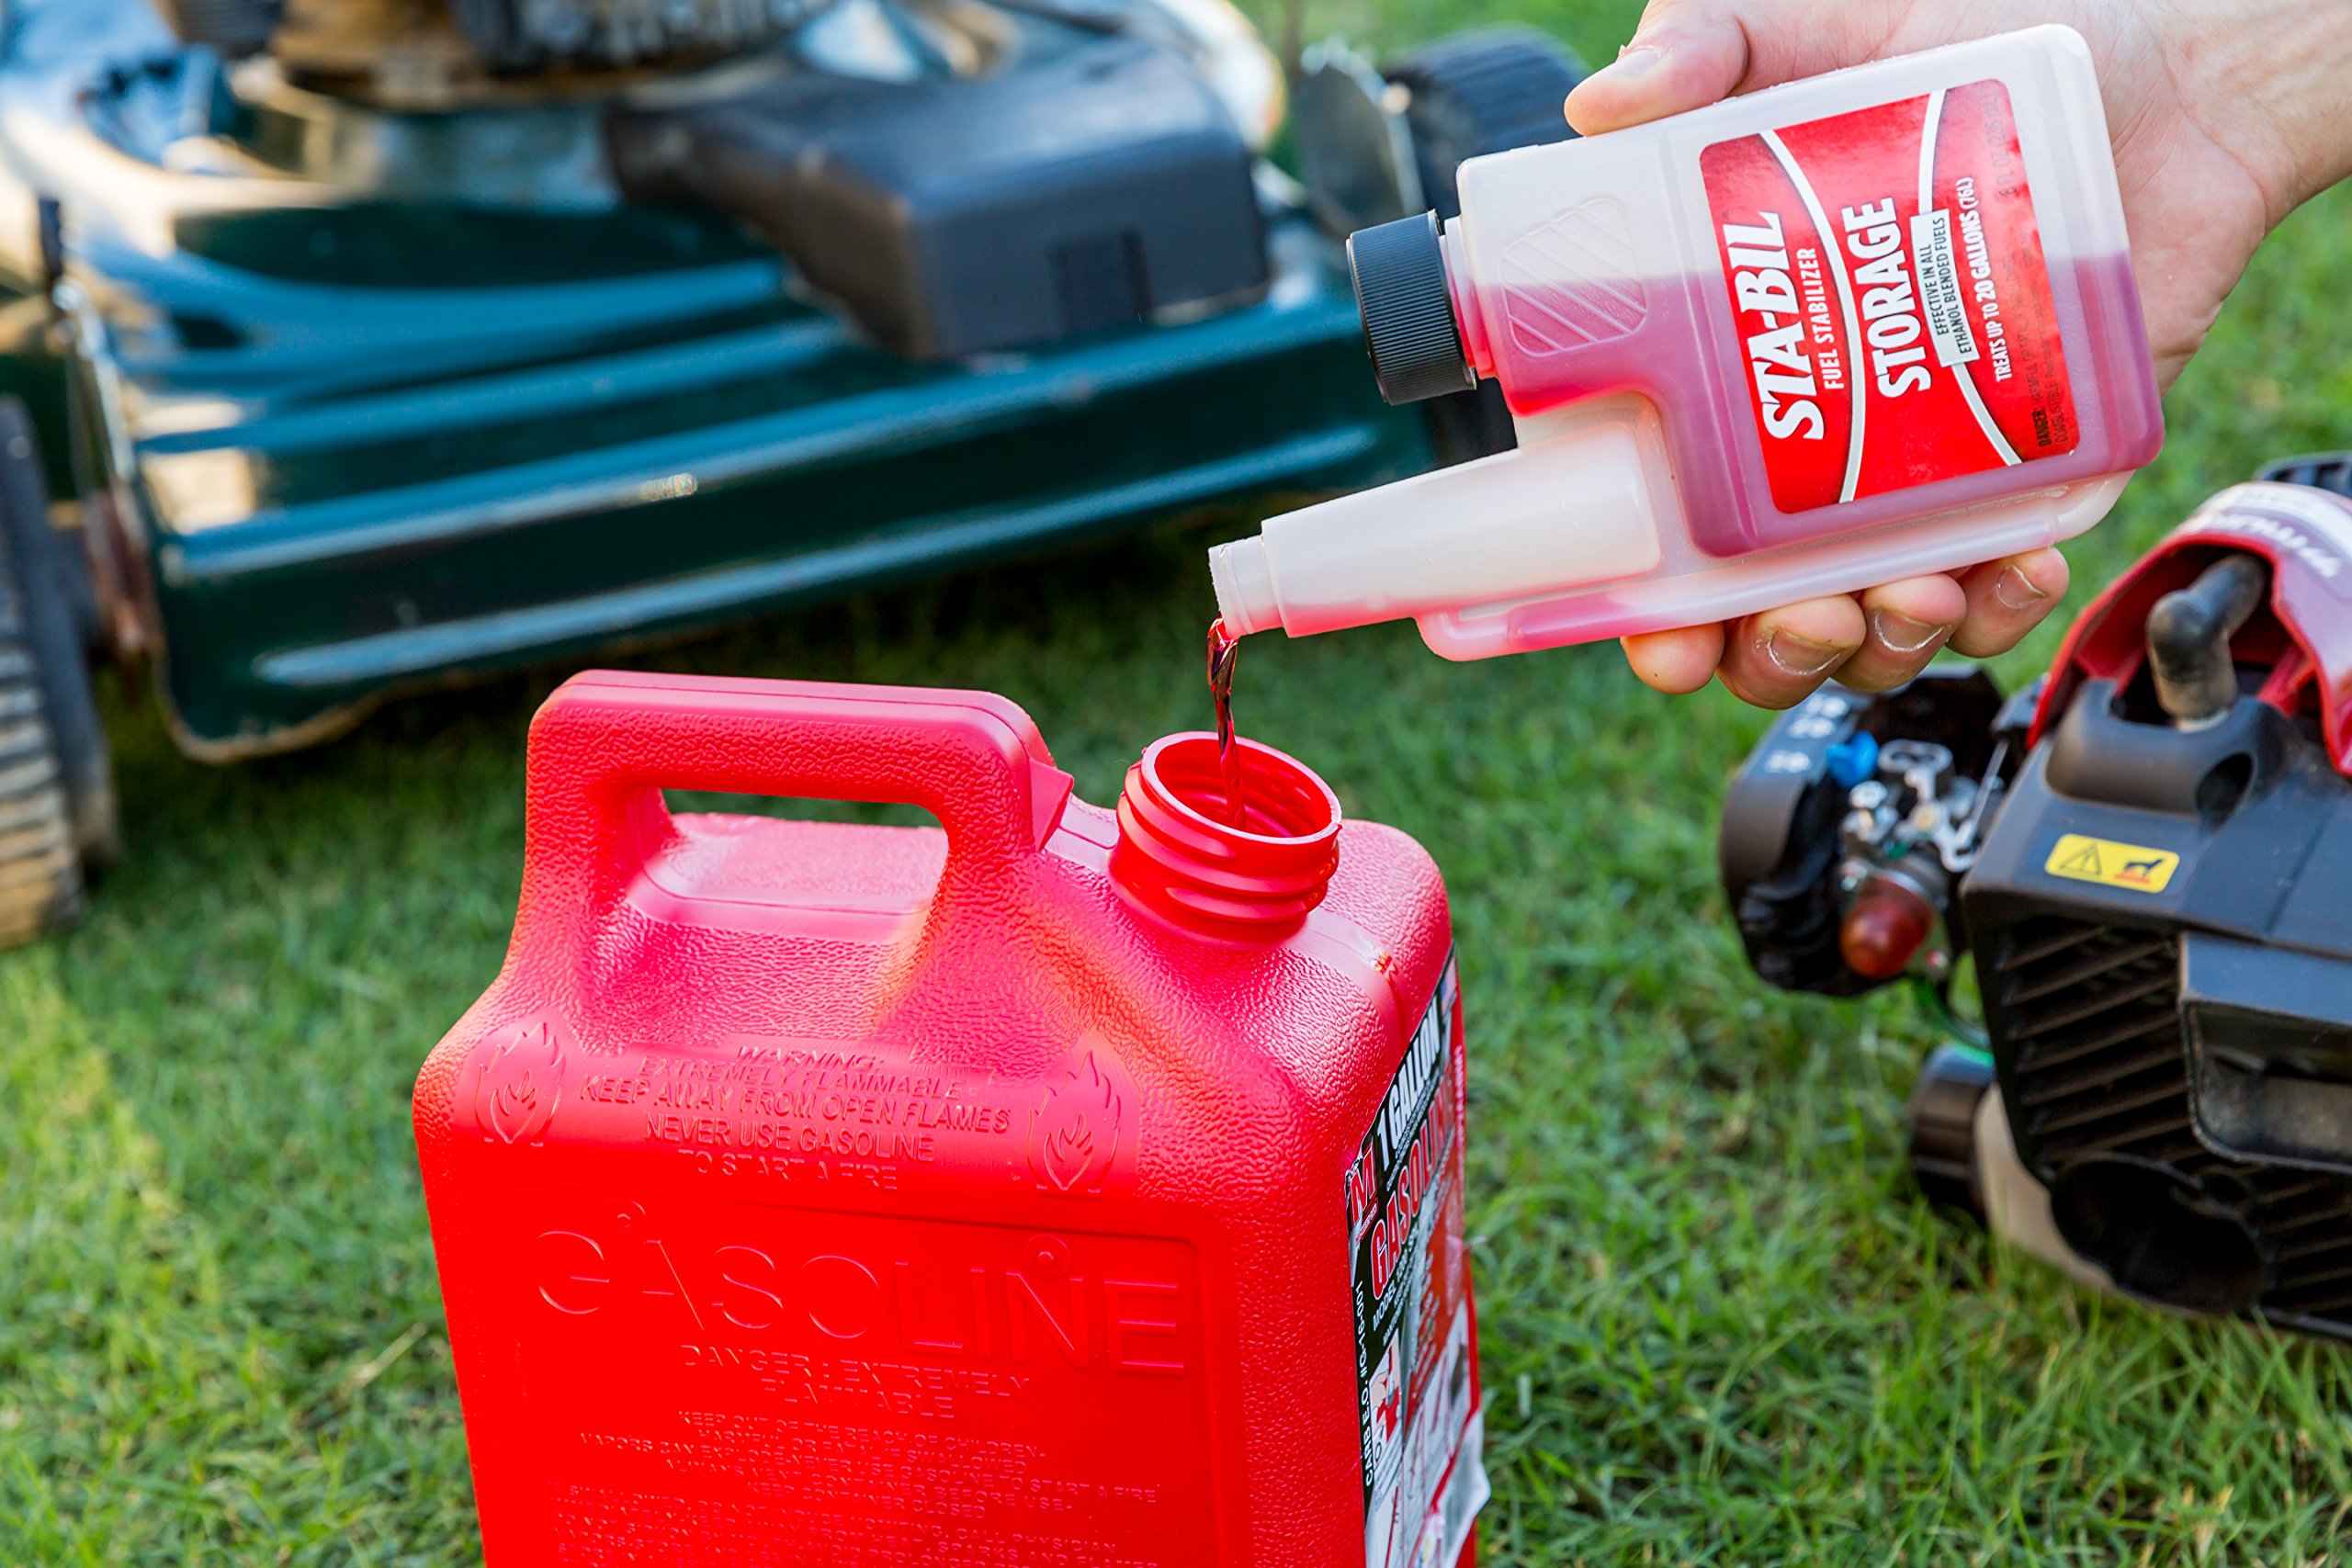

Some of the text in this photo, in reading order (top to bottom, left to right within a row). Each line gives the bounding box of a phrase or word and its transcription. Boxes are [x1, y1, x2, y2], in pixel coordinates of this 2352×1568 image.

[1841, 197, 1931, 398] STORAGE
[1919, 243, 1949, 336] EFFECTIVE IN ALL
[1932, 216, 1973, 355] ETHANOL BLENDED FUELS
[1955, 176, 2013, 382] TREATS UP TO 20 GALLONS (76L)
[1723, 211, 1825, 440] STA-BIL
[1797, 247, 1845, 390] FUEL STABILIZER
[579, 1075, 1012, 1135] KEEP AWAY FROM OPEN FLAMES
[639, 1055, 964, 1101] EXTREMELY FLAMMABLE
[1378, 1108, 1390, 1172] 1
[1388, 995, 1441, 1150] GALLON
[644, 1111, 934, 1163] NEVER USE GASOLINE
[677, 1148, 714, 1175] TO
[721, 1151, 806, 1181] START
[838, 1162, 899, 1190] FIRE
[534, 1228, 1185, 1375] GASOLINE
[1373, 1279, 1396, 1332] MODEL
[839, 1359, 1030, 1397] EXTREMELY
[675, 1409, 727, 1428] KEEP
[1363, 1426, 1374, 1486] CARB
